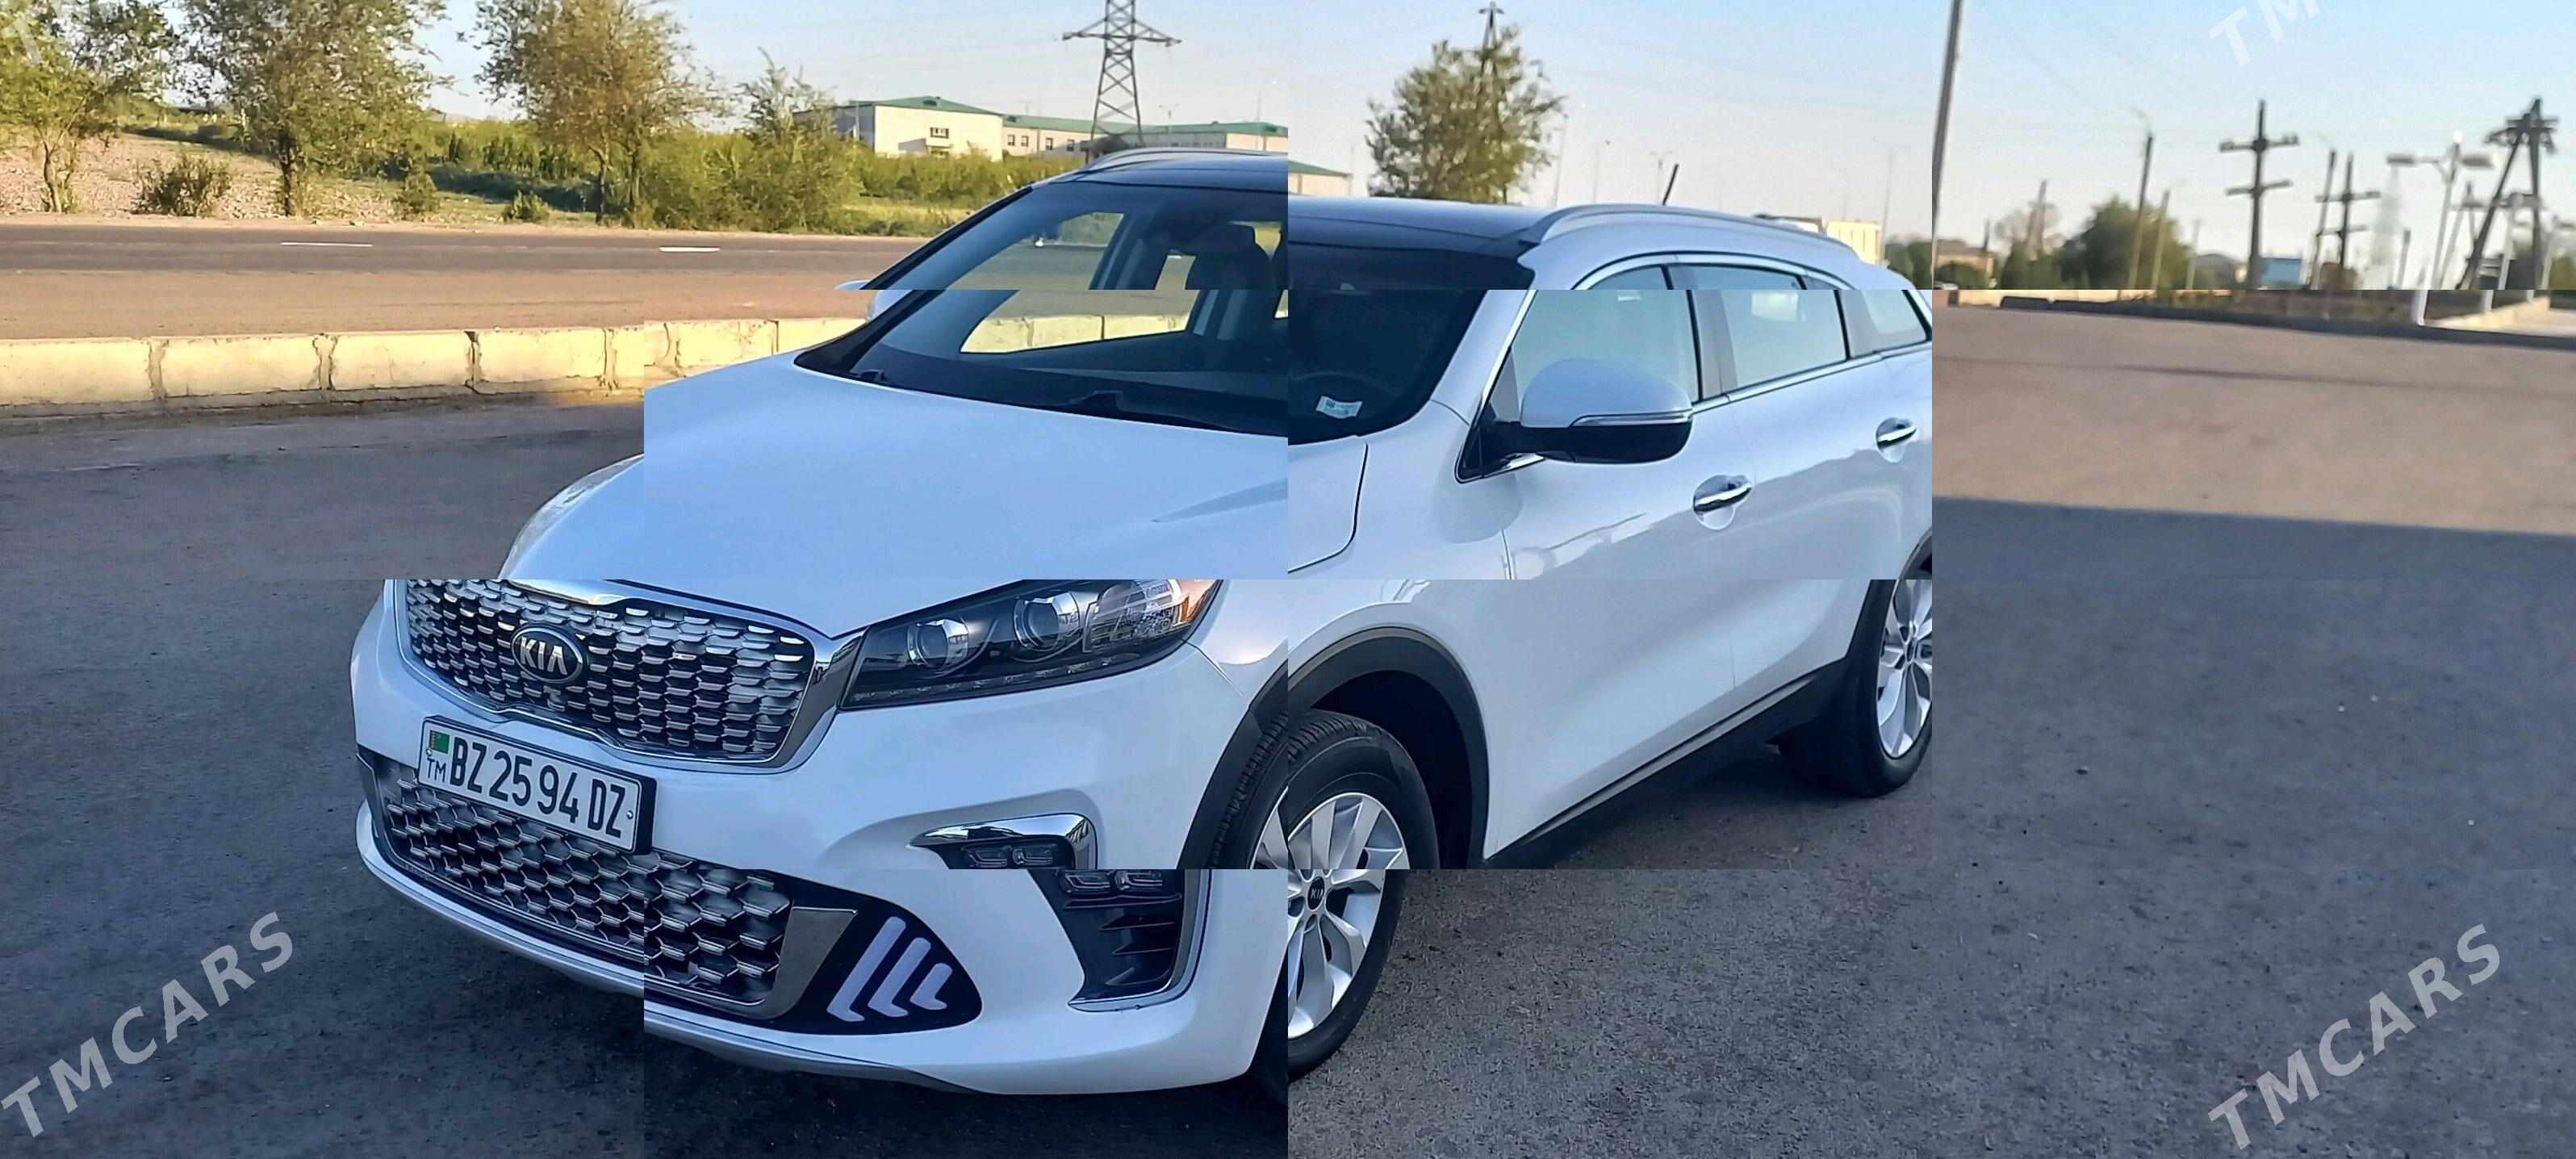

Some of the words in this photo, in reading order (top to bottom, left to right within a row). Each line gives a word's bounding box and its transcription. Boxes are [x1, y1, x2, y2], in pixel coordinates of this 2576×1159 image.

[521, 636, 568, 676] KIA
[427, 758, 446, 783] TM
[450, 737, 487, 794] BZ
[588, 778, 626, 839] DZ
